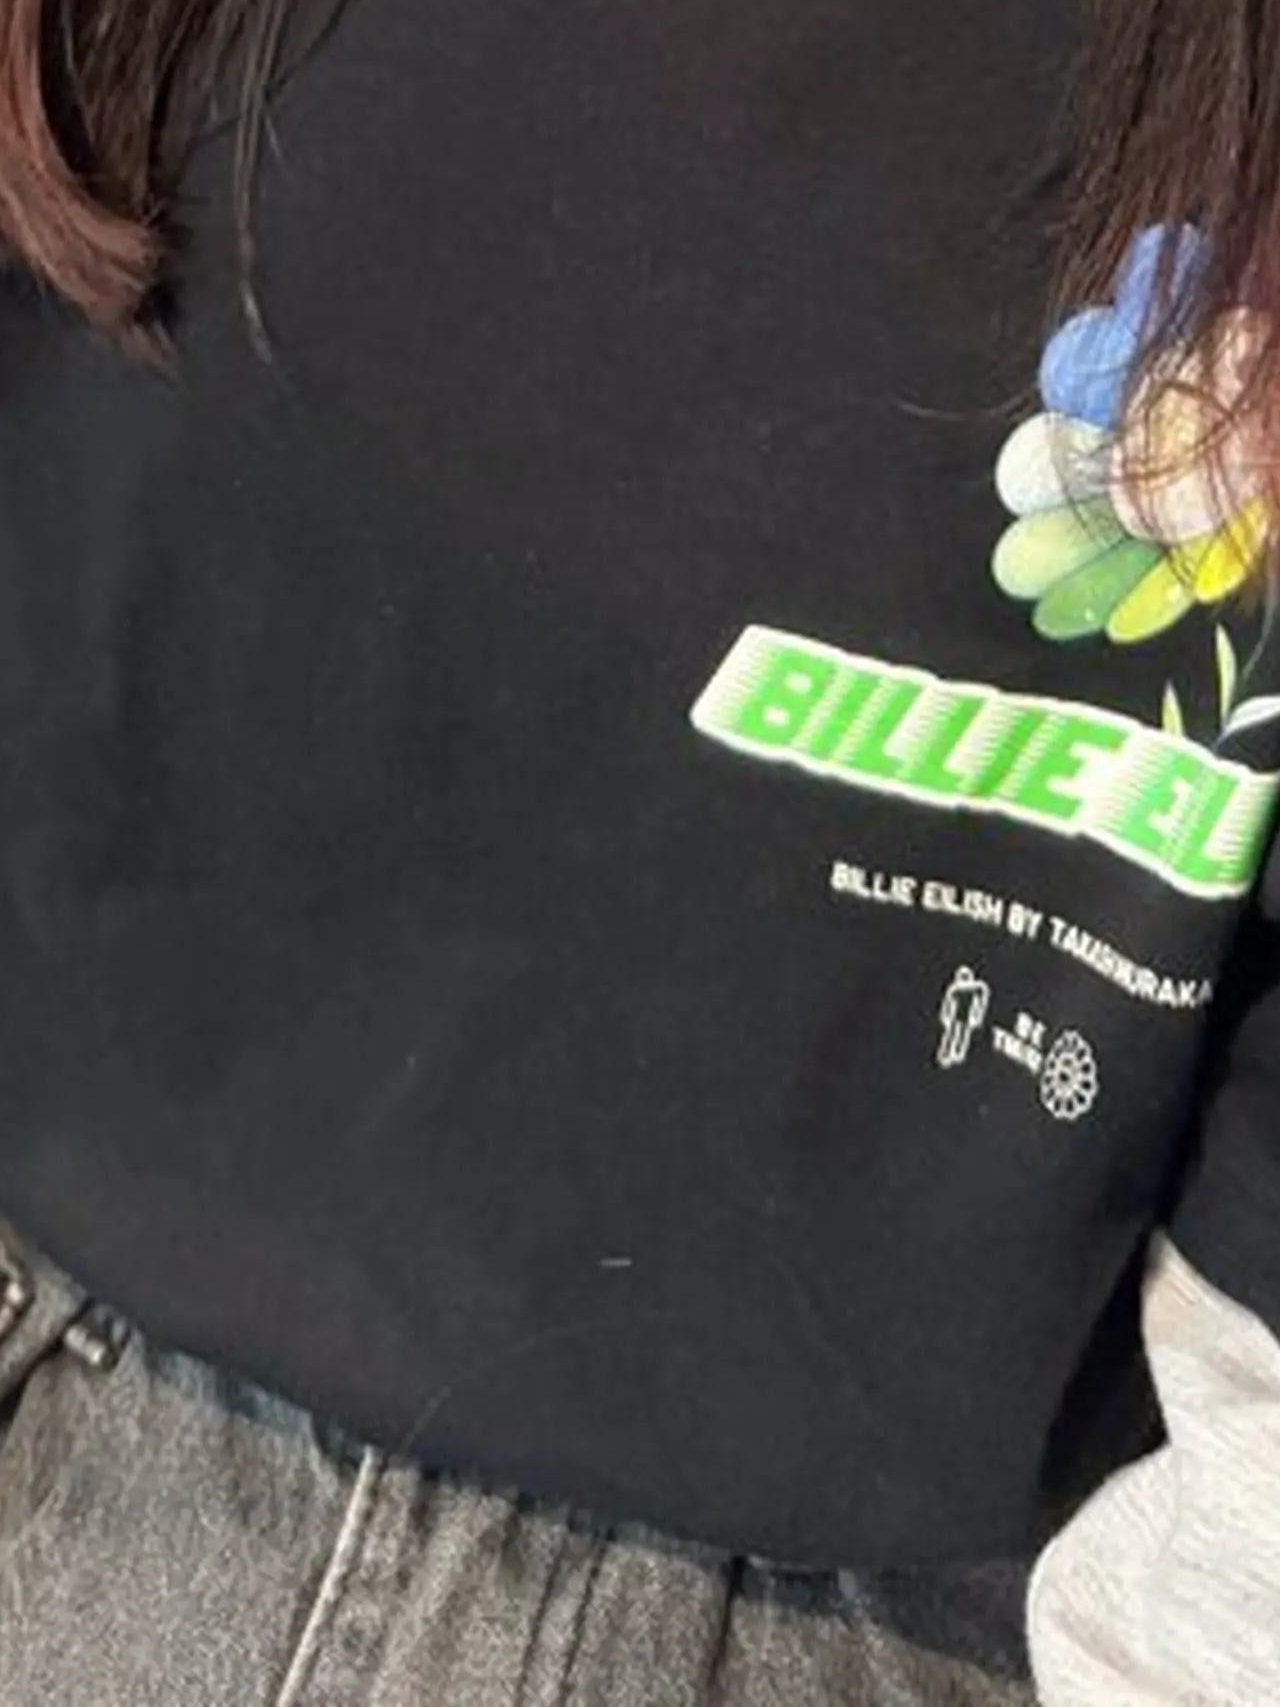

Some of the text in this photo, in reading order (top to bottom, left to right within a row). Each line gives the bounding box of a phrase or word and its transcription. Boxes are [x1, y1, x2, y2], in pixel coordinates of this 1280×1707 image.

[732, 643, 1132, 823] BILLIE
[830, 860, 917, 908] BILLIE
[922, 880, 1005, 928] EILISH
[1007, 900, 1043, 940] BY
